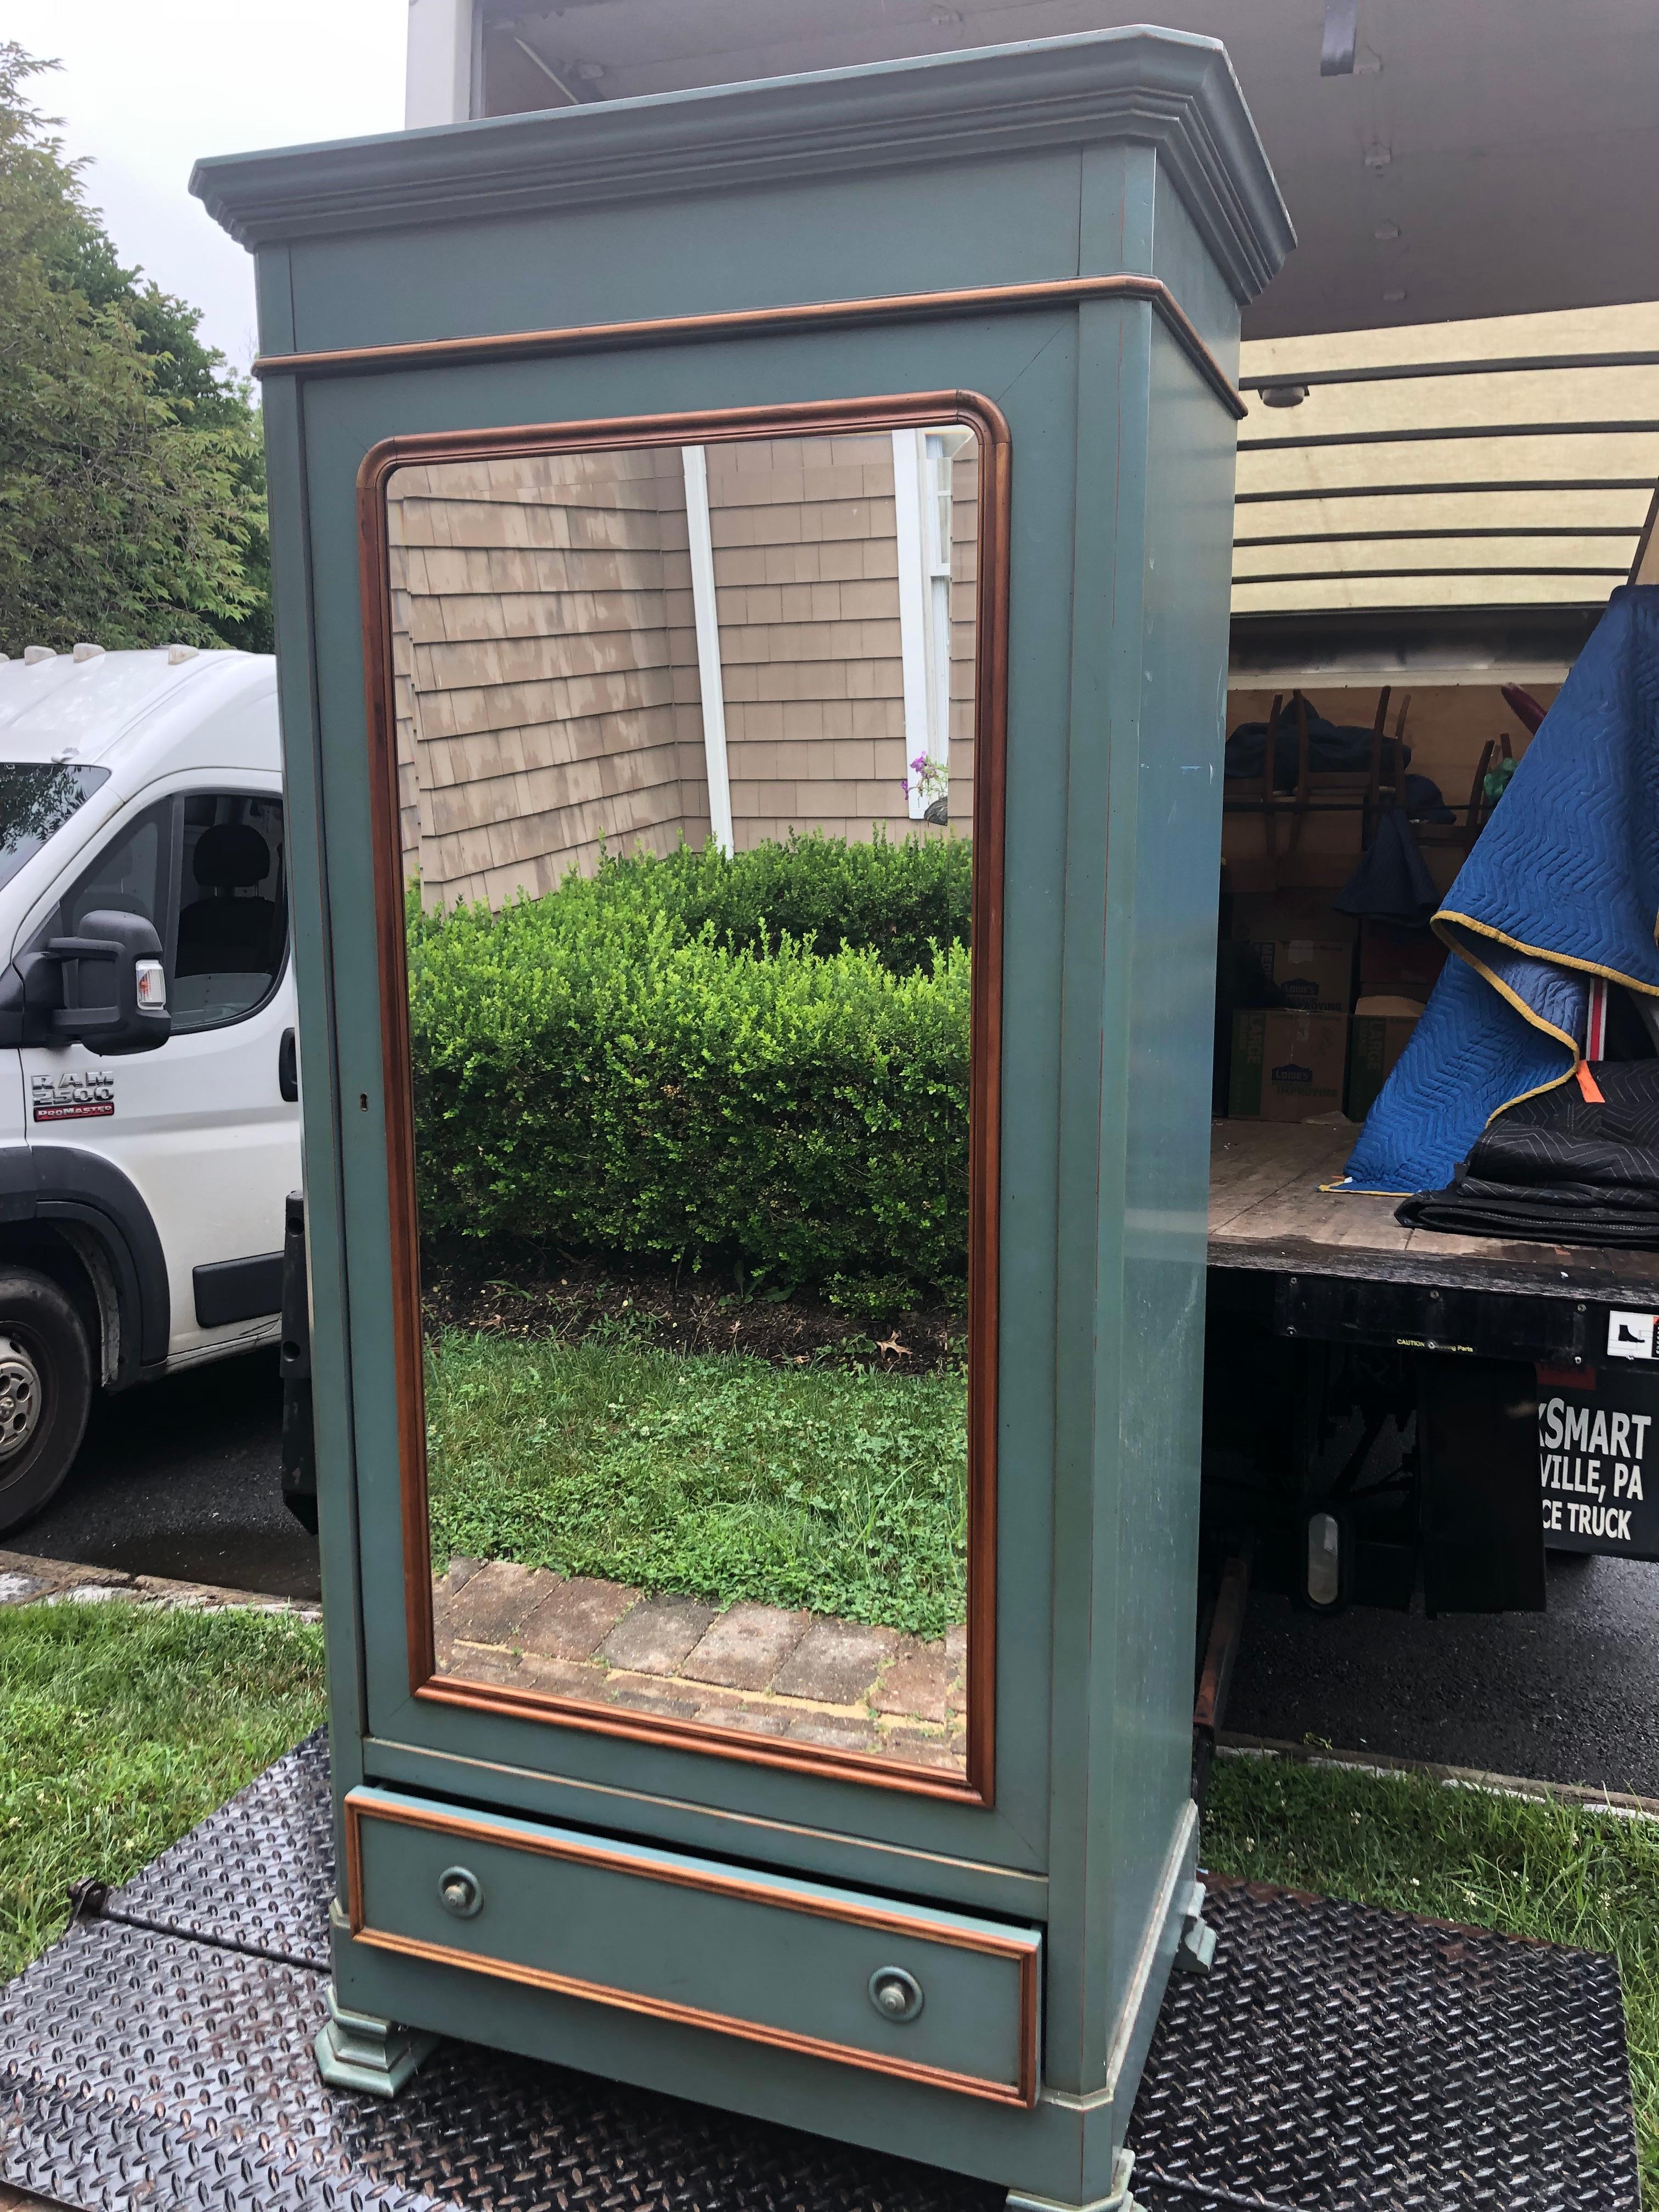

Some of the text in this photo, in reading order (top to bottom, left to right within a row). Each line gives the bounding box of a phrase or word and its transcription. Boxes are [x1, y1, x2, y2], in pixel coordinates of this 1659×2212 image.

[31, 1071, 114, 1090] RAM
[1276, 1069, 1309, 1081] LOWE'S
[32, 1086, 114, 1106] 2500
[1396, 1339, 1425, 1347] CAUTION
[1613, 1463, 1643, 1501] PA
[1567, 1503, 1632, 1541] TRUCK
